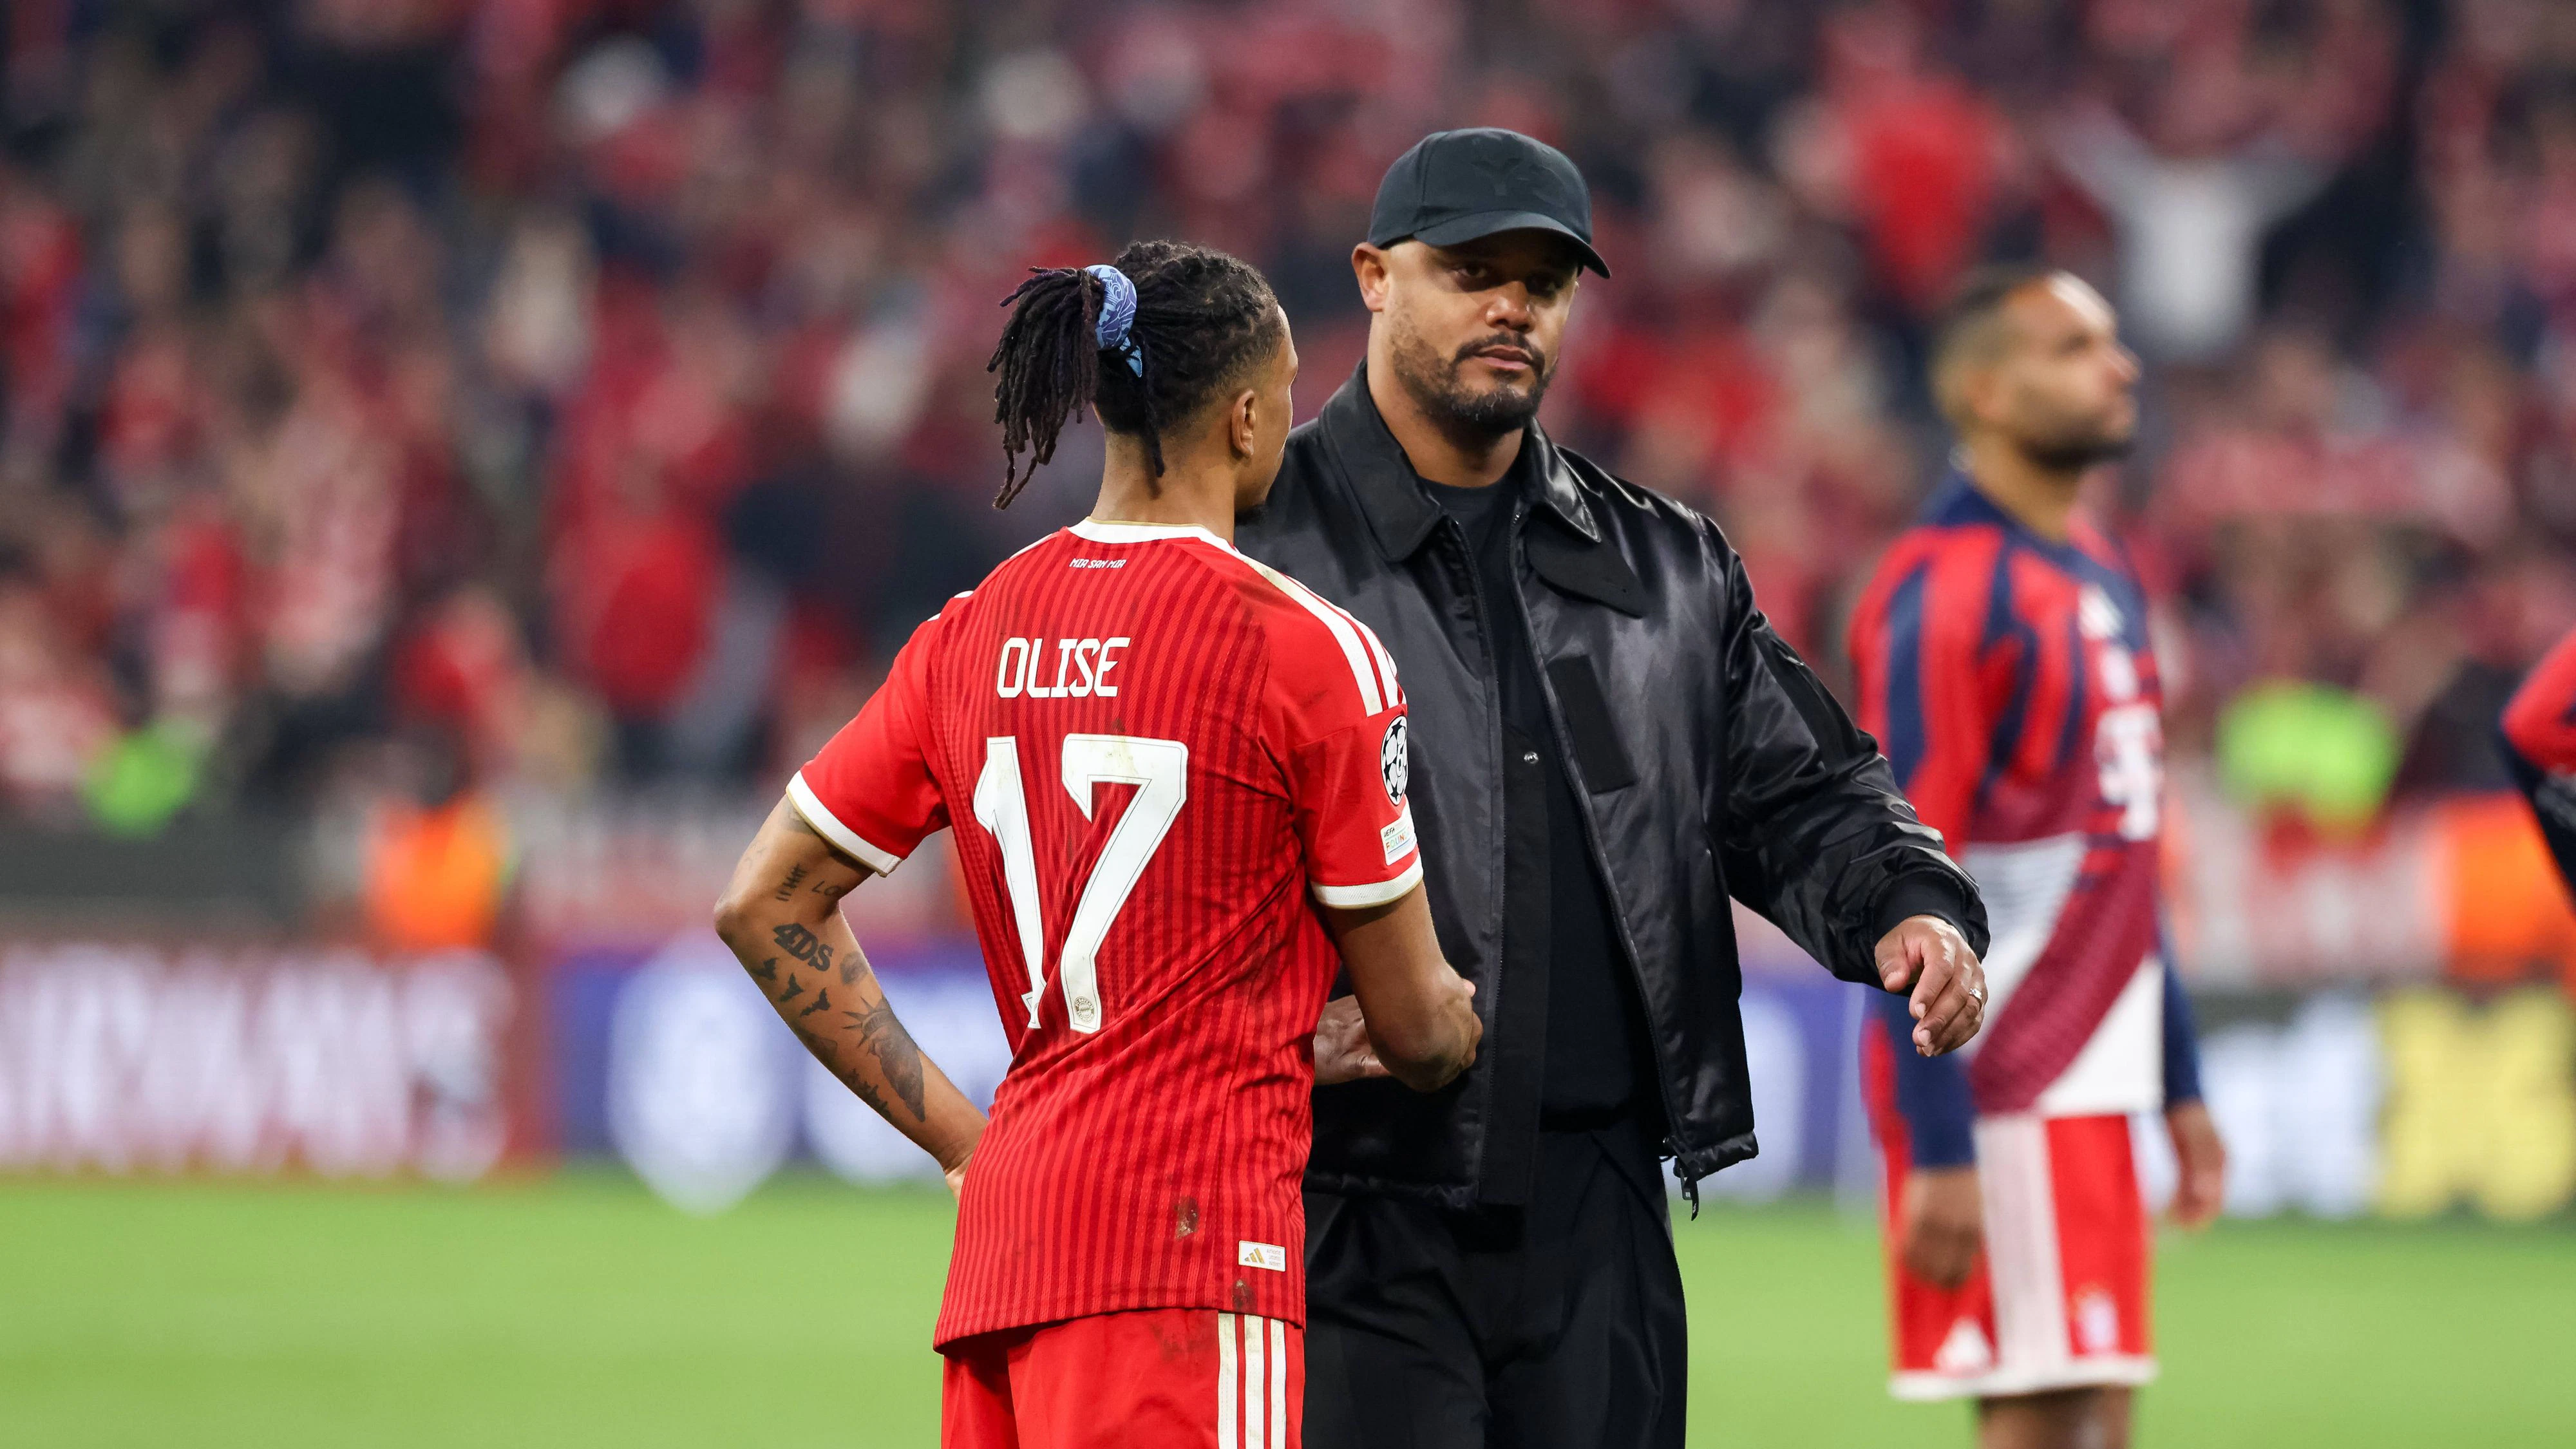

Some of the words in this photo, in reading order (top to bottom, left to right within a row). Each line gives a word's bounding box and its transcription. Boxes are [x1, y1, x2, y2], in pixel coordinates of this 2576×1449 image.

[1069, 558, 1089, 568] MIA
[1087, 559, 1109, 569] SAN
[1106, 559, 1127, 568] MIA
[996, 637, 1131, 698] OLISE
[1383, 827, 1395, 838] UEFA
[973, 733, 1189, 1034] 17
[773, 922, 834, 972] 4DS
